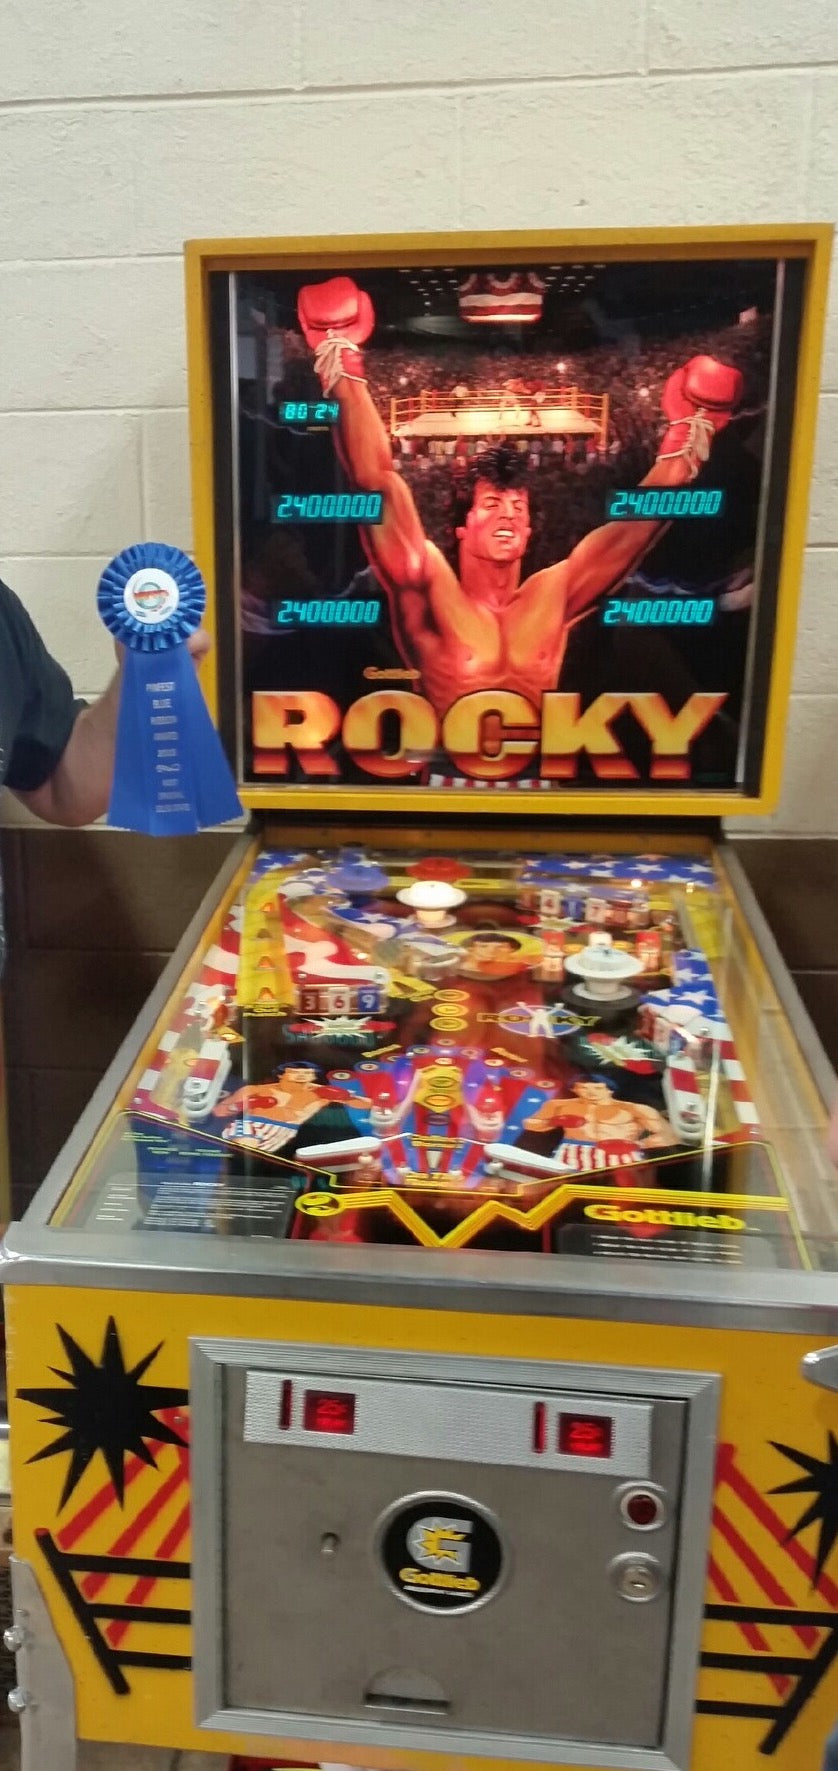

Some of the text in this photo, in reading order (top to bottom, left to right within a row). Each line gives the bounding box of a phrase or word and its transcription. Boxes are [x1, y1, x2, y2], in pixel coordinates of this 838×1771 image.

[314, 402, 340, 420] 24
[277, 494, 382, 518] 2400000
[609, 490, 723, 516] 2400000
[277, 600, 380, 624] 2400000
[603, 599, 714, 624] 2400000
[252, 690, 729, 780] ROCKY
[304, 995, 317, 1011] 3
[361, 994, 376, 1009] 9
[476, 1012, 602, 1027] ROKY
[583, 1204, 746, 1231] Gottlieb
